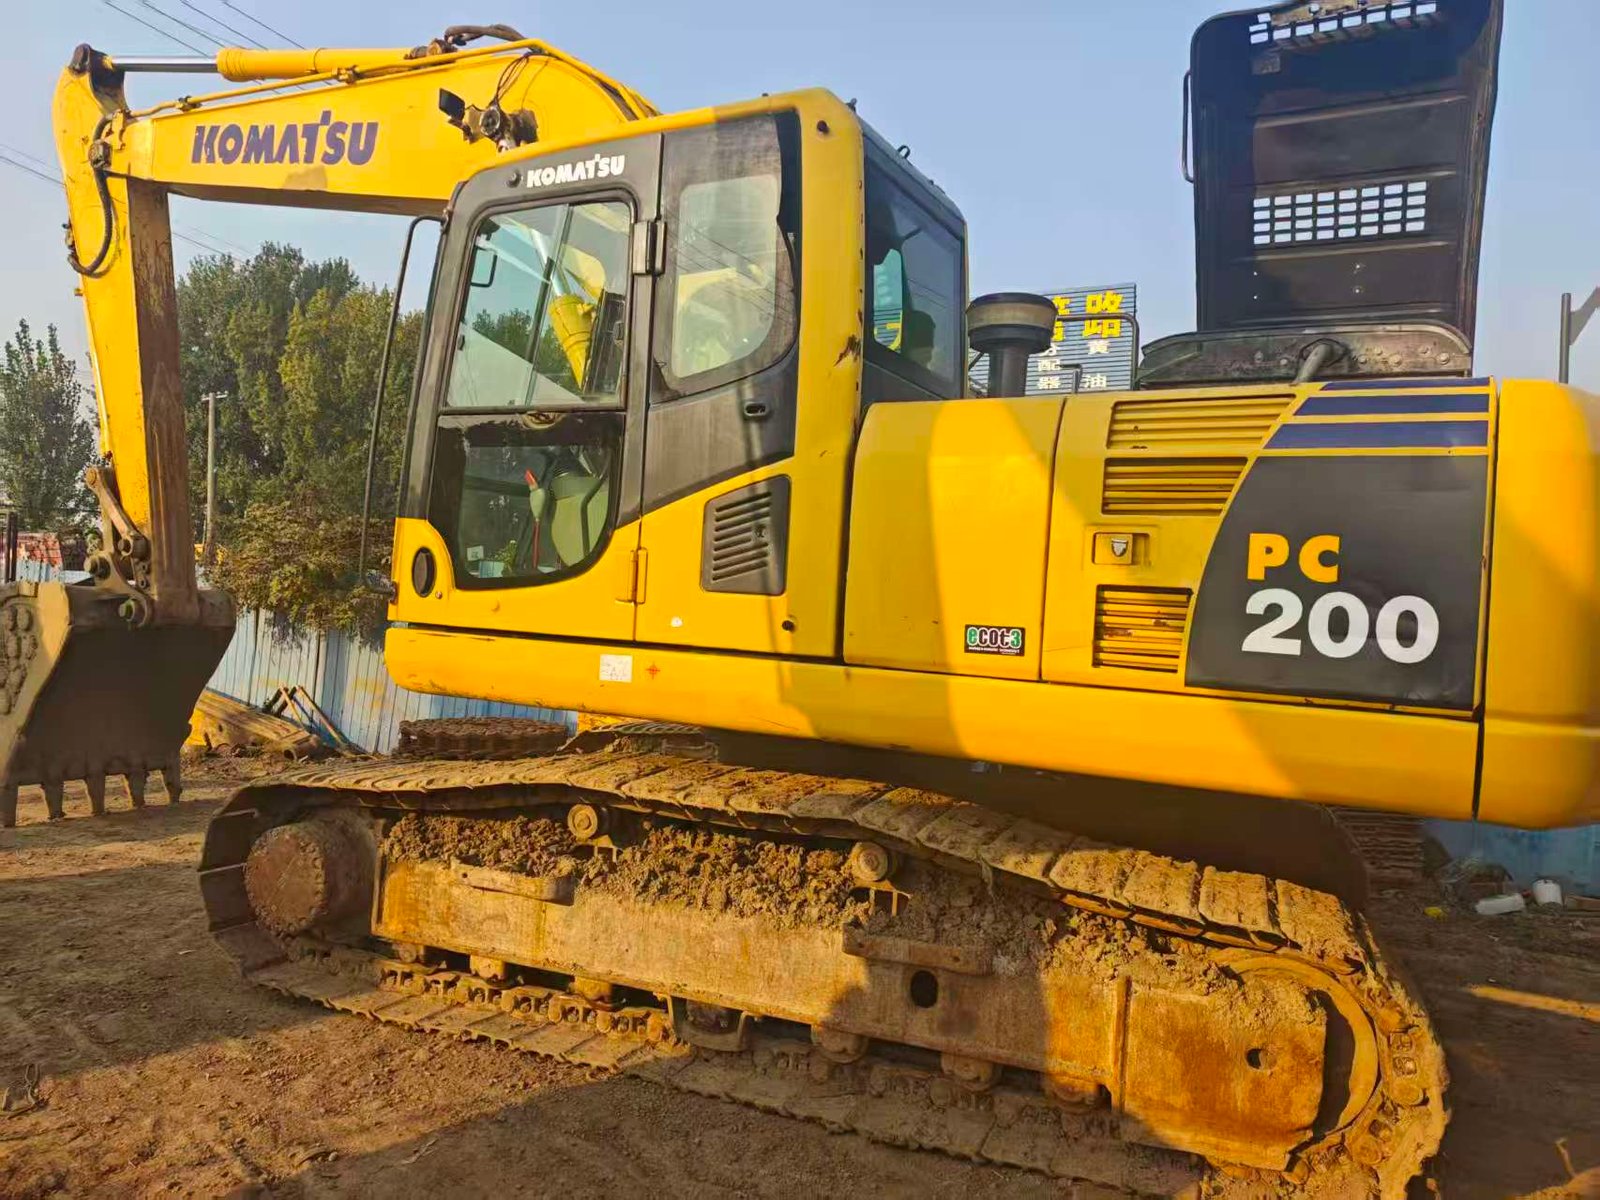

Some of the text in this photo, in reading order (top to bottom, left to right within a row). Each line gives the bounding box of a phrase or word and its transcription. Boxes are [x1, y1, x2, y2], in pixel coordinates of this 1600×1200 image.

[191, 110, 379, 166] KOMATSU
[526, 153, 625, 188] KOMATSU
[1247, 532, 1340, 584] PC
[1241, 588, 1440, 664] 200
